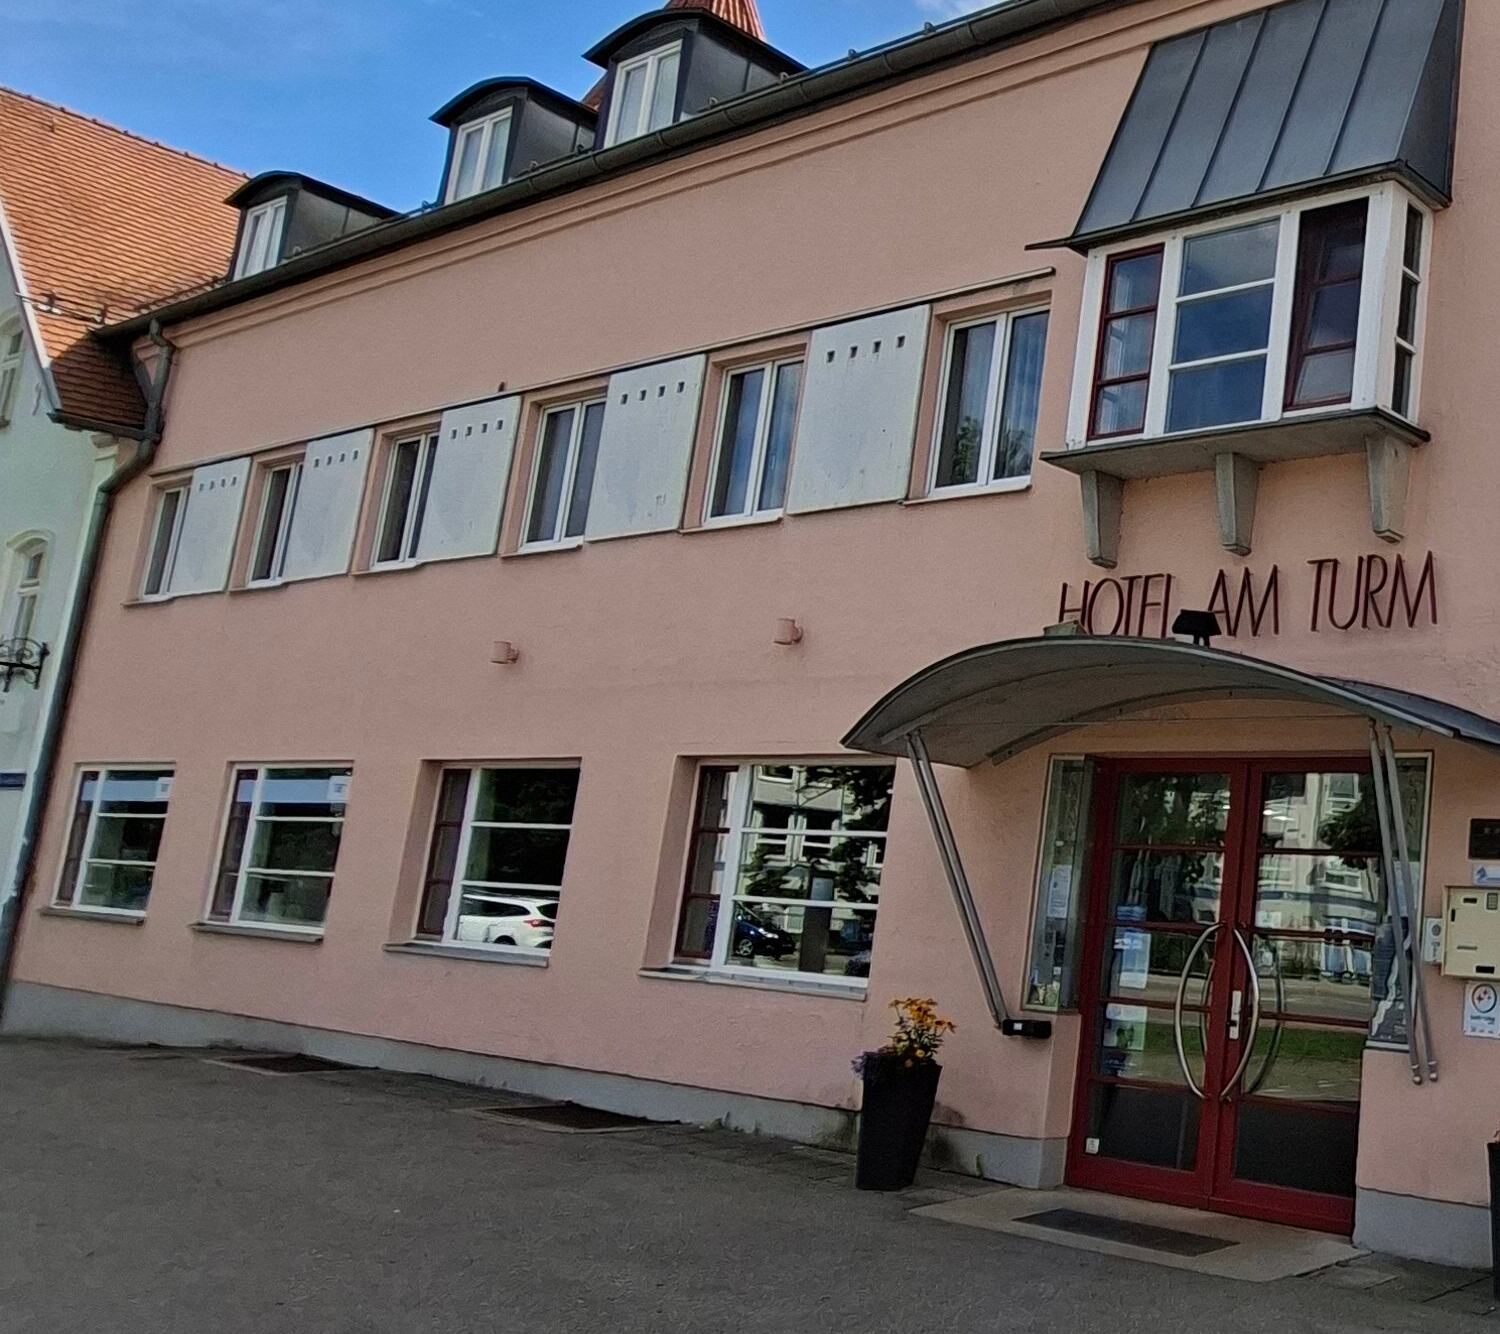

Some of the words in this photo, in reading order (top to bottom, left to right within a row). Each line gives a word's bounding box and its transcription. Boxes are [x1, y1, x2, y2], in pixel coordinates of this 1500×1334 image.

[1059, 573, 1175, 640] HOTEL
[1207, 564, 1280, 637] AM
[1306, 550, 1438, 632] TURM
